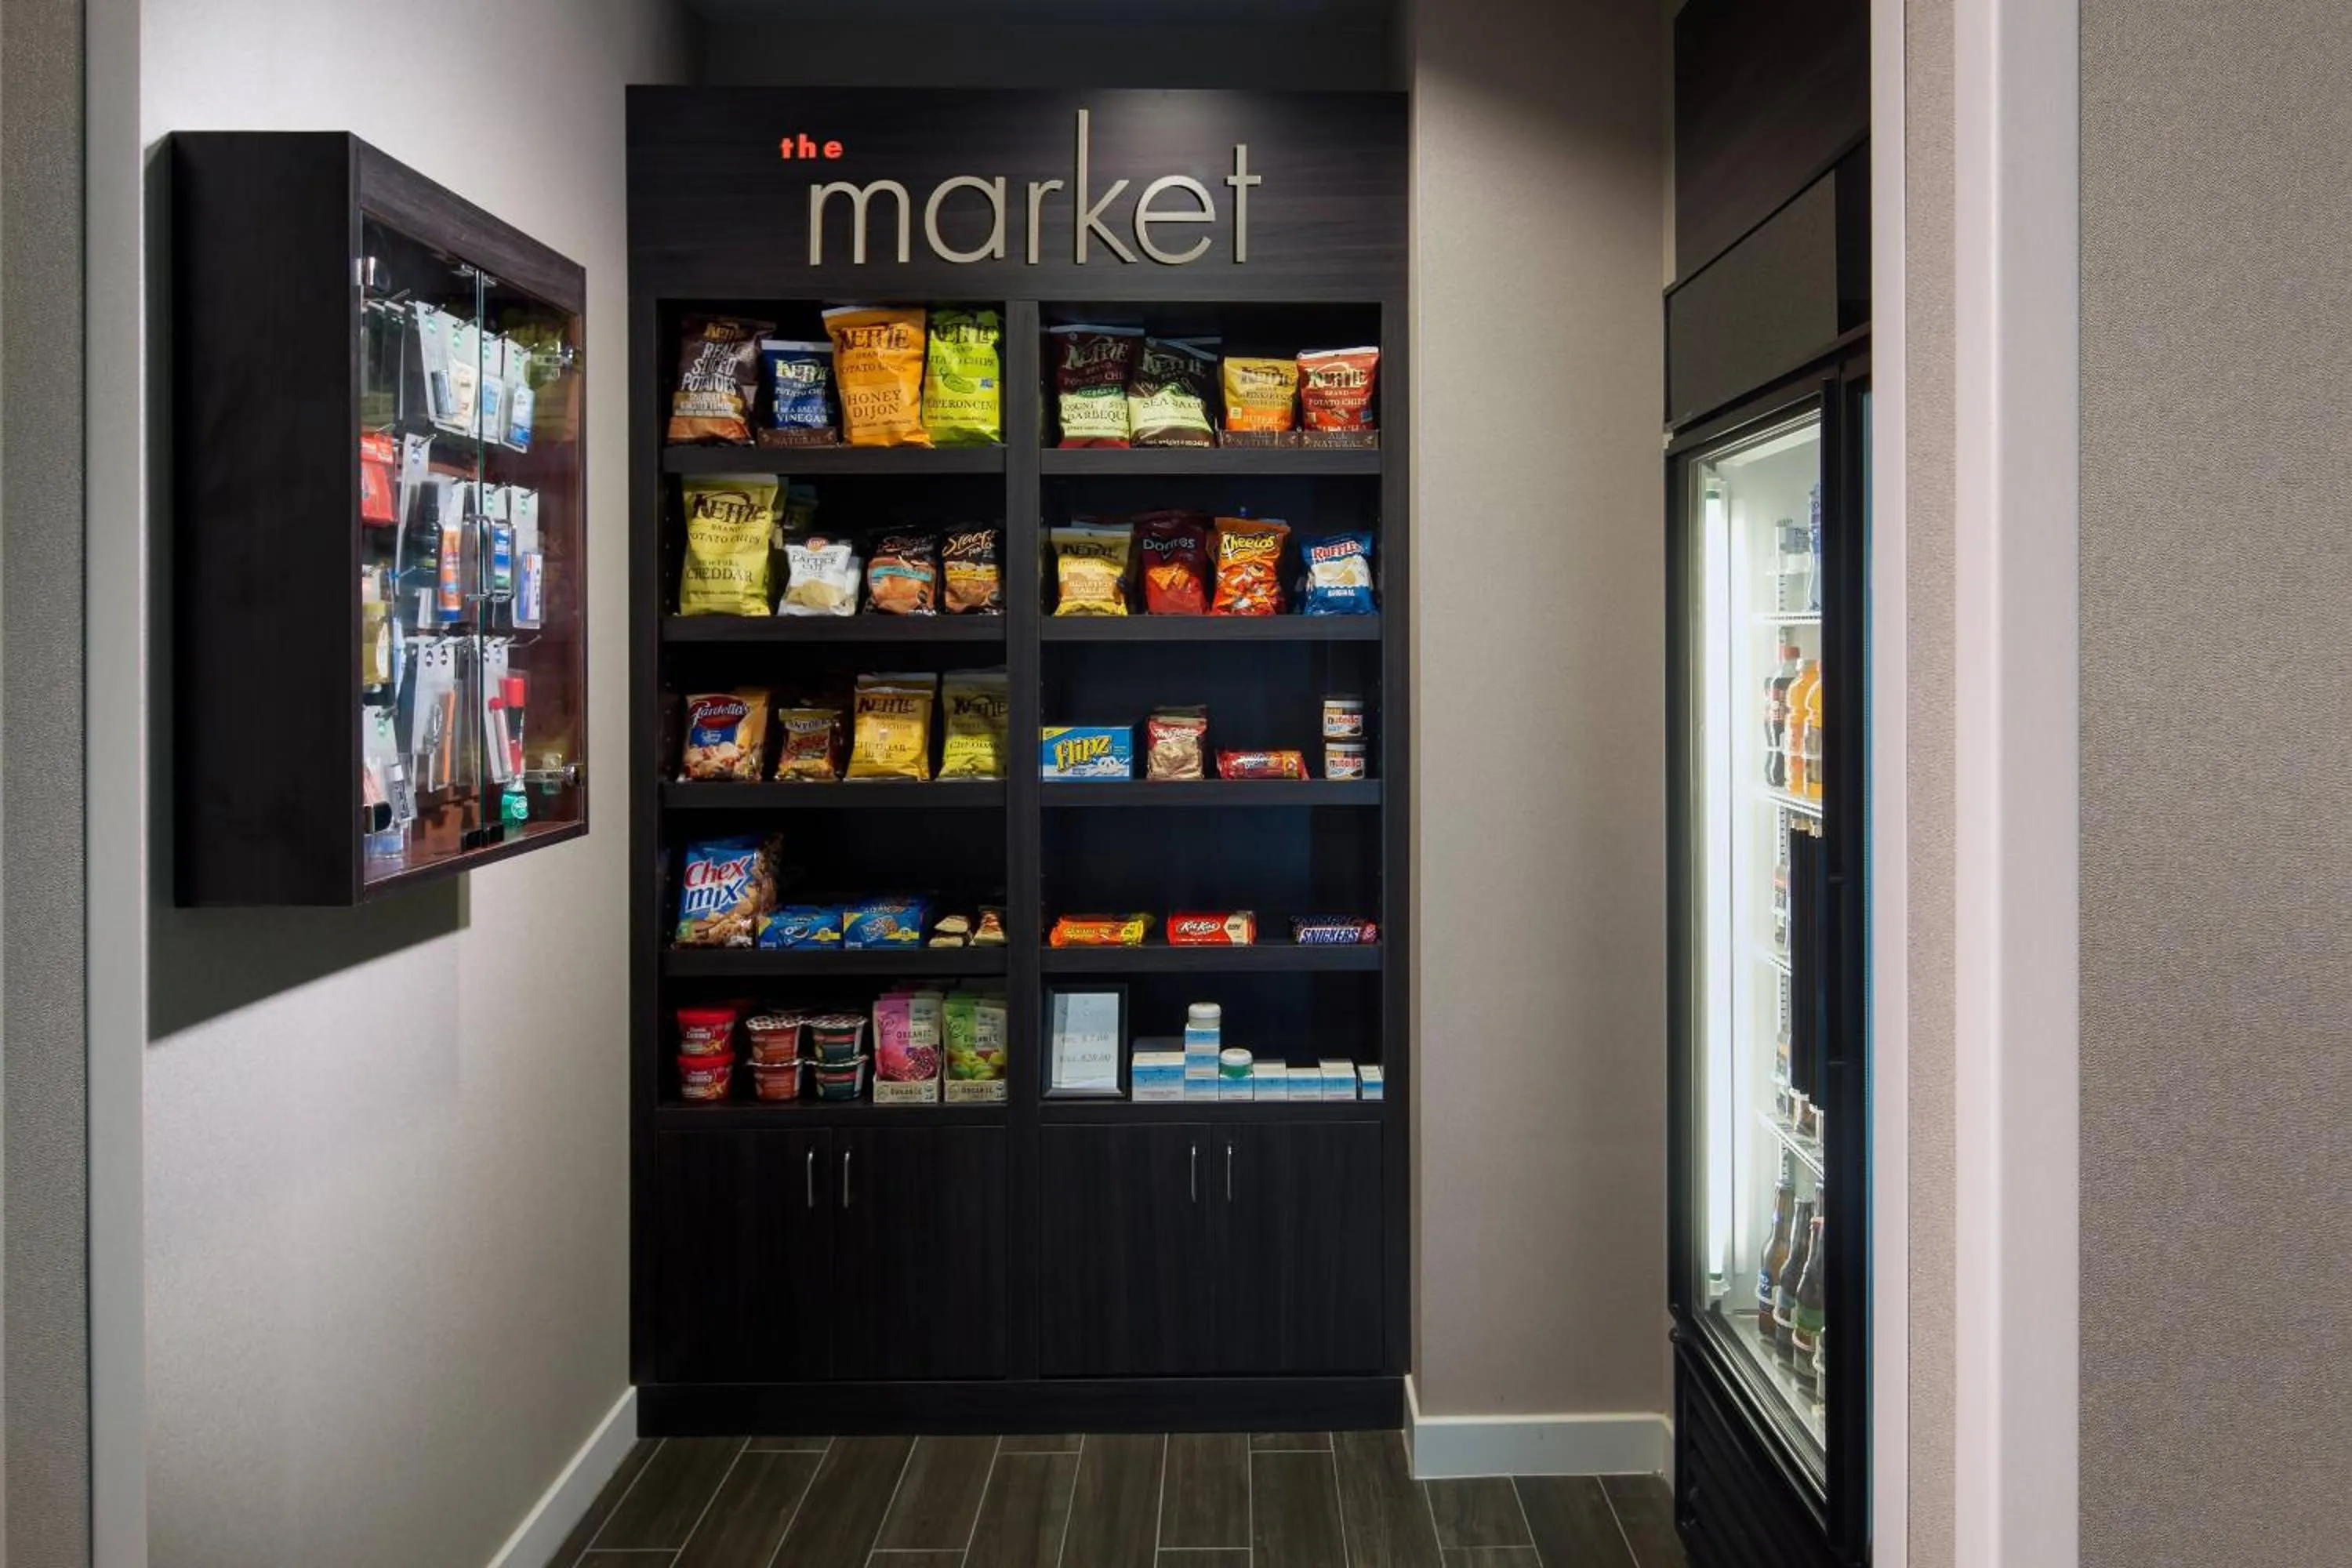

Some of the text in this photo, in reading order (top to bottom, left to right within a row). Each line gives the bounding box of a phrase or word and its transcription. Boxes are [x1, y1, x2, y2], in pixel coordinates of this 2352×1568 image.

[781, 133, 843, 158] the
[809, 109, 1261, 265] market
[847, 390, 902, 405] HONEY
[853, 403, 900, 419] DIJON
[692, 492, 768, 524] KETTLE
[1142, 537, 1196, 551] Doritos
[1221, 533, 1277, 556] Cheetos
[686, 567, 753, 583] CHEDDAR
[685, 856, 751, 888] Chex
[687, 877, 746, 909] mix
[1301, 927, 1360, 943] SNICKERS
